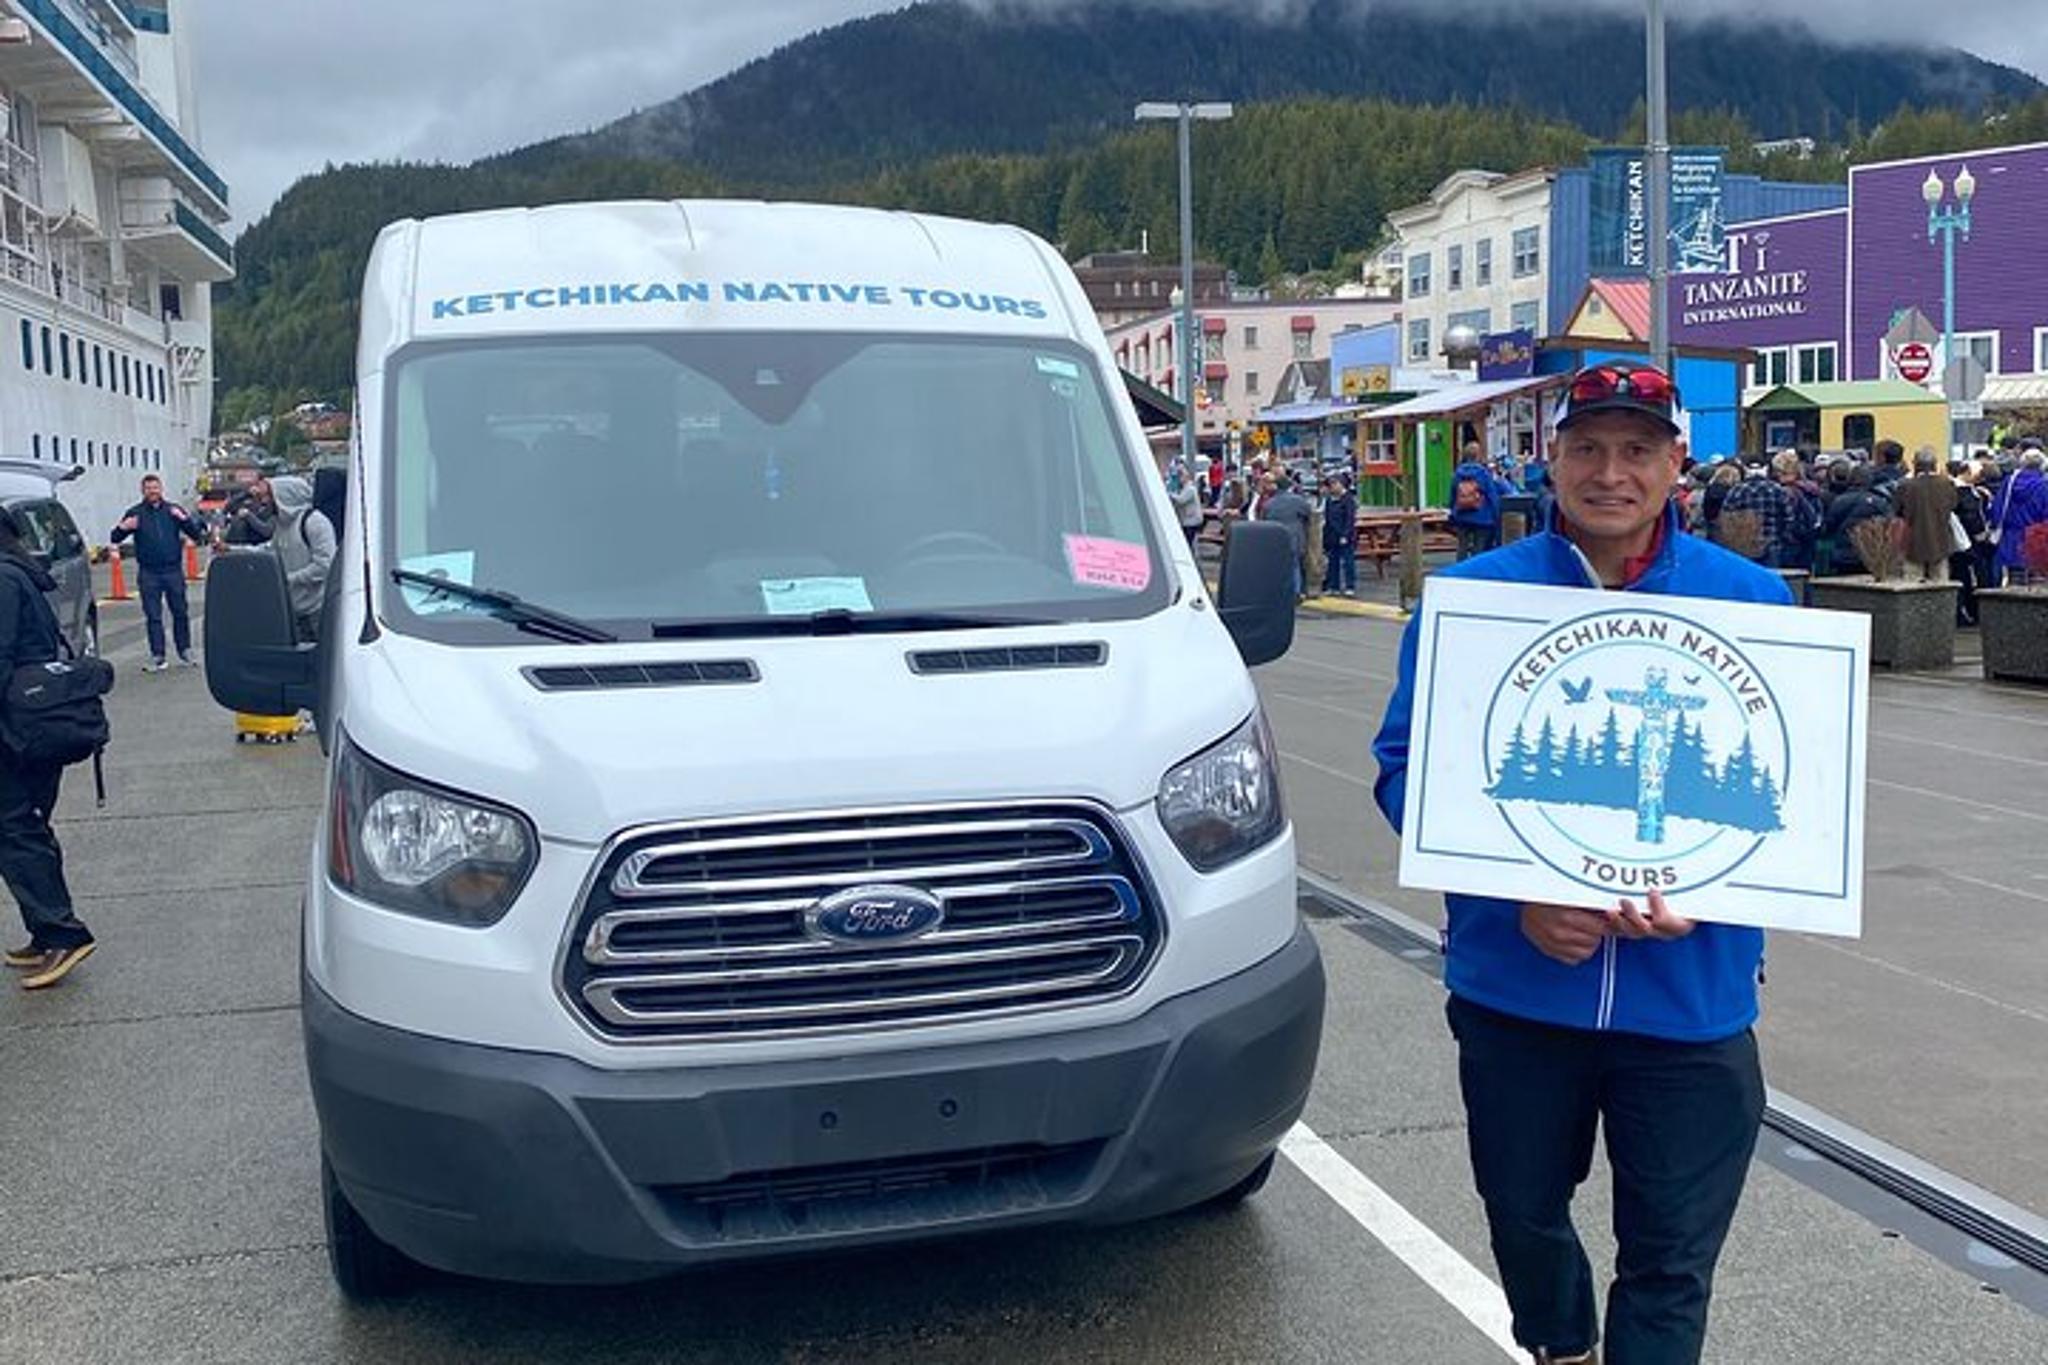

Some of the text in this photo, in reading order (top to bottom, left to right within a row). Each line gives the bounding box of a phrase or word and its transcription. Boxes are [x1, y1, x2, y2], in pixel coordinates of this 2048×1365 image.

[1628, 161, 1644, 265] KETCHIKAN
[432, 282, 1047, 319] KETCHIKAN NATIVE TOURS
[1684, 270, 1807, 305] TANZANITE
[1683, 301, 1807, 325] INTERNATIONAL
[1513, 618, 1767, 715] KETCHIKAN NATIVE
[1582, 856, 1677, 886] TOURS
[844, 901, 914, 932] Ford
